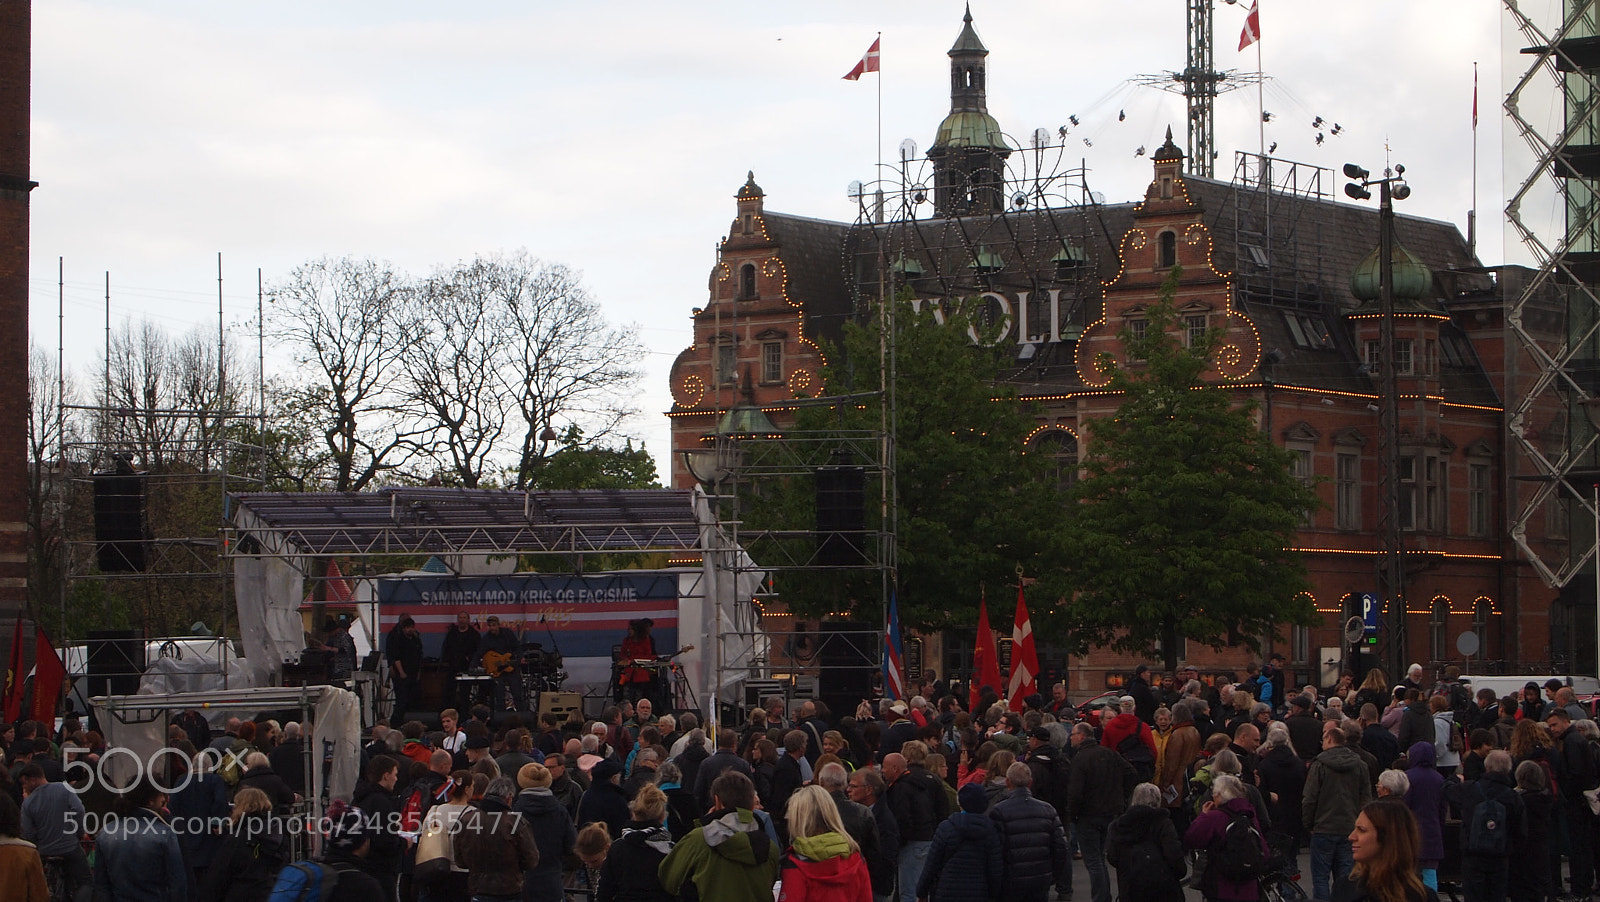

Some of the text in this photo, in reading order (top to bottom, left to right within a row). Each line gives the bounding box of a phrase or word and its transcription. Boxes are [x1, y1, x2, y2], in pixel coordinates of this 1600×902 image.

[421, 587, 637, 606] SAMMEN MOD KRIG OG FACISME
[536, 606, 575, 628] 1945
[1364, 598, 1371, 619] P
